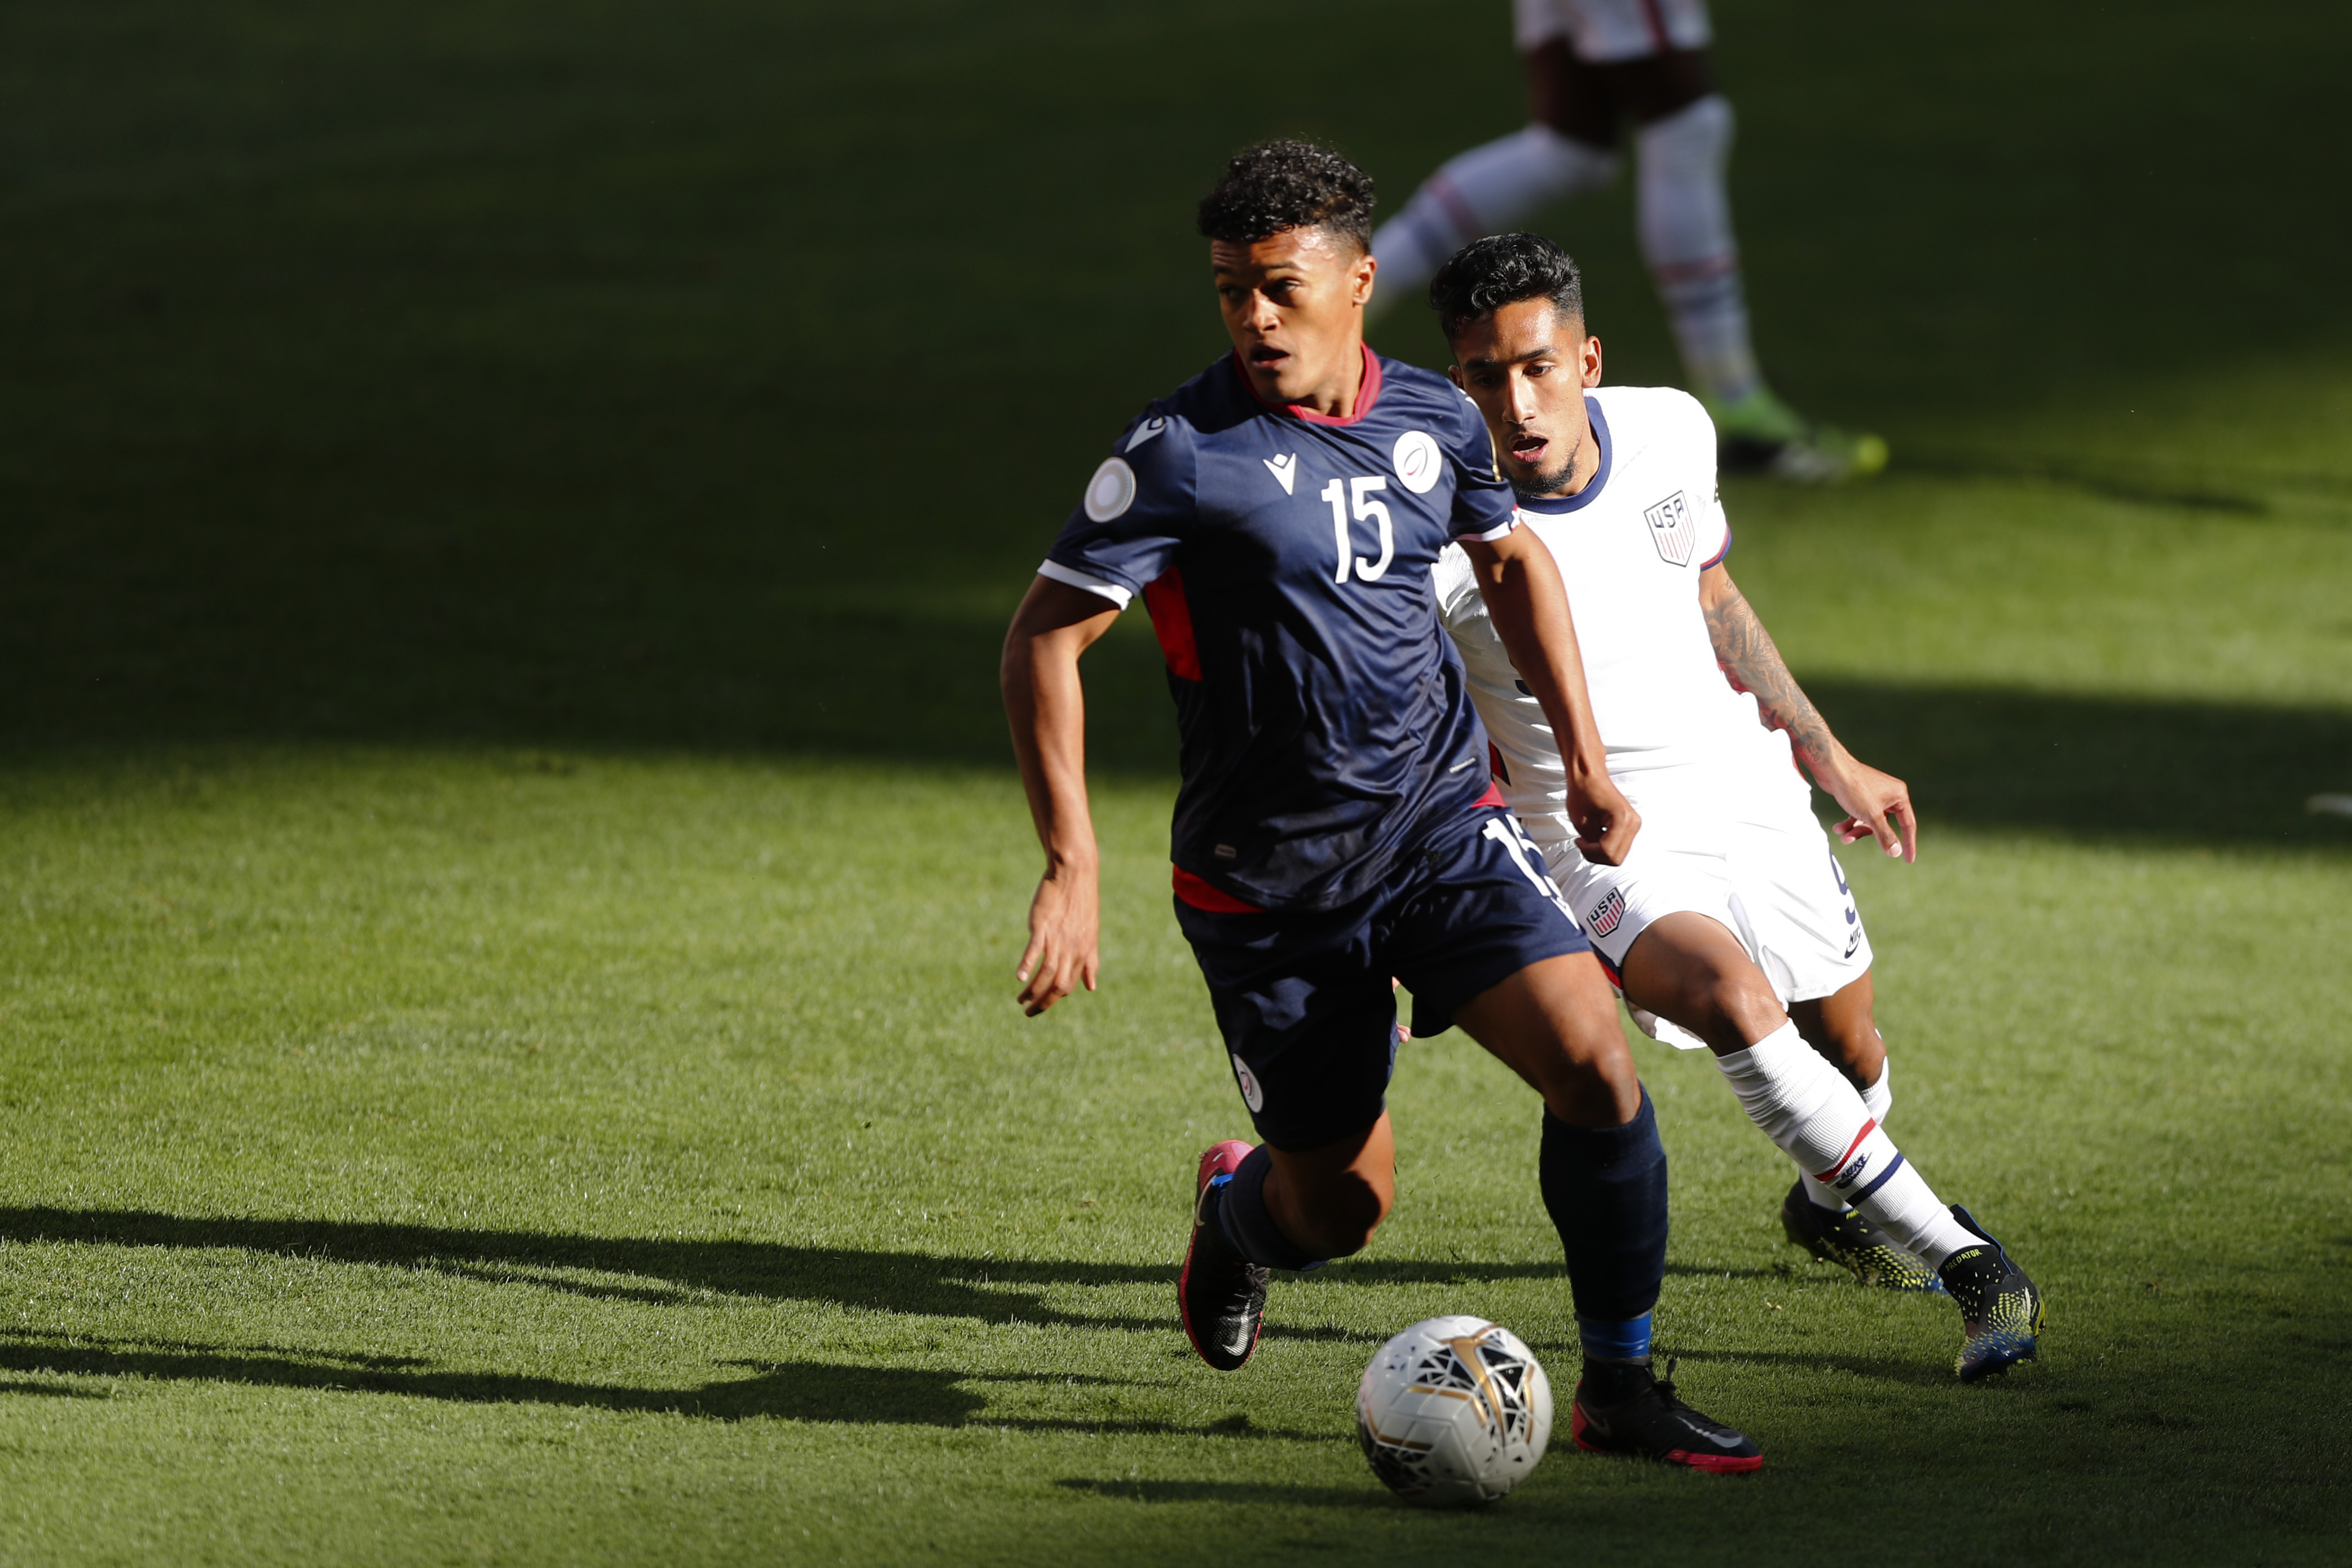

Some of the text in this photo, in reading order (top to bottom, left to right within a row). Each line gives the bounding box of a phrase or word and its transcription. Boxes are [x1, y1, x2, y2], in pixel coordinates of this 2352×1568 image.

[1650, 497, 1684, 528] USA
[1321, 476, 1395, 584] 15
[1590, 891, 1615, 922] USA
[1945, 1249, 1983, 1272] PREDATOR
